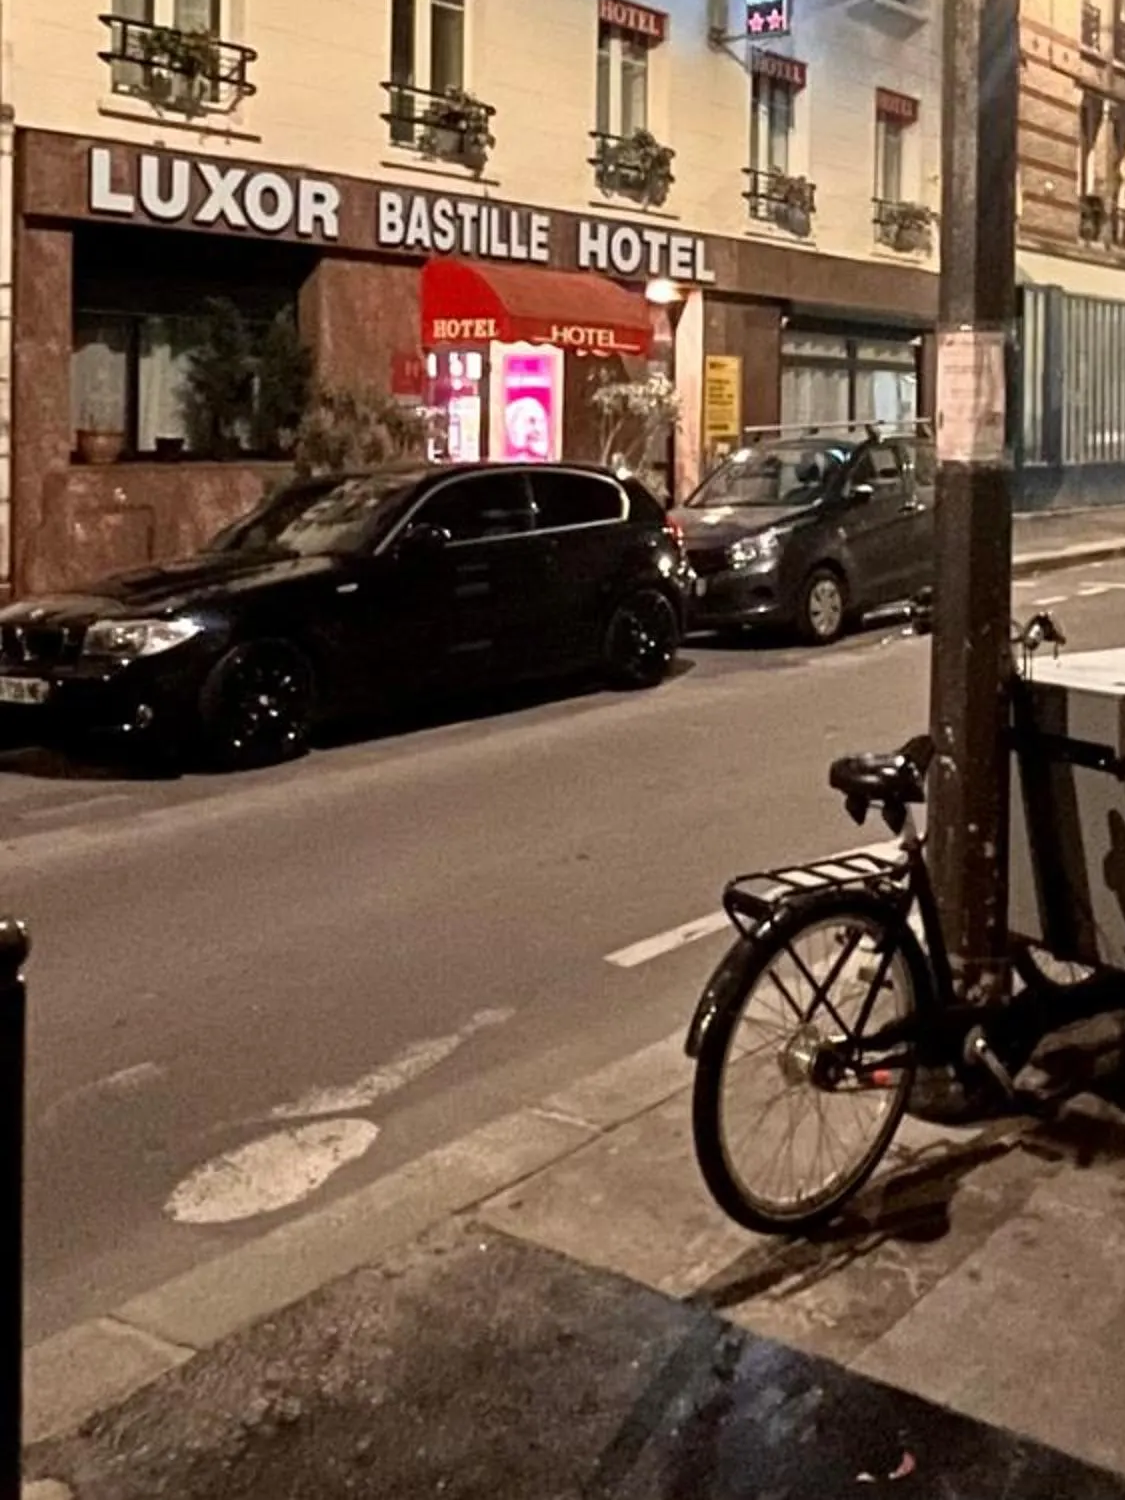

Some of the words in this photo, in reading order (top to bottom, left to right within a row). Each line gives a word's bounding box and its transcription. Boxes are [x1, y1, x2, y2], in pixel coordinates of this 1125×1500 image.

[91, 148, 340, 238] LUXOR
[378, 191, 549, 261] BASTILLE
[578, 221, 715, 282] HOTEL
[433, 318, 497, 339] HOTEL
[551, 324, 620, 348] HOTEL
